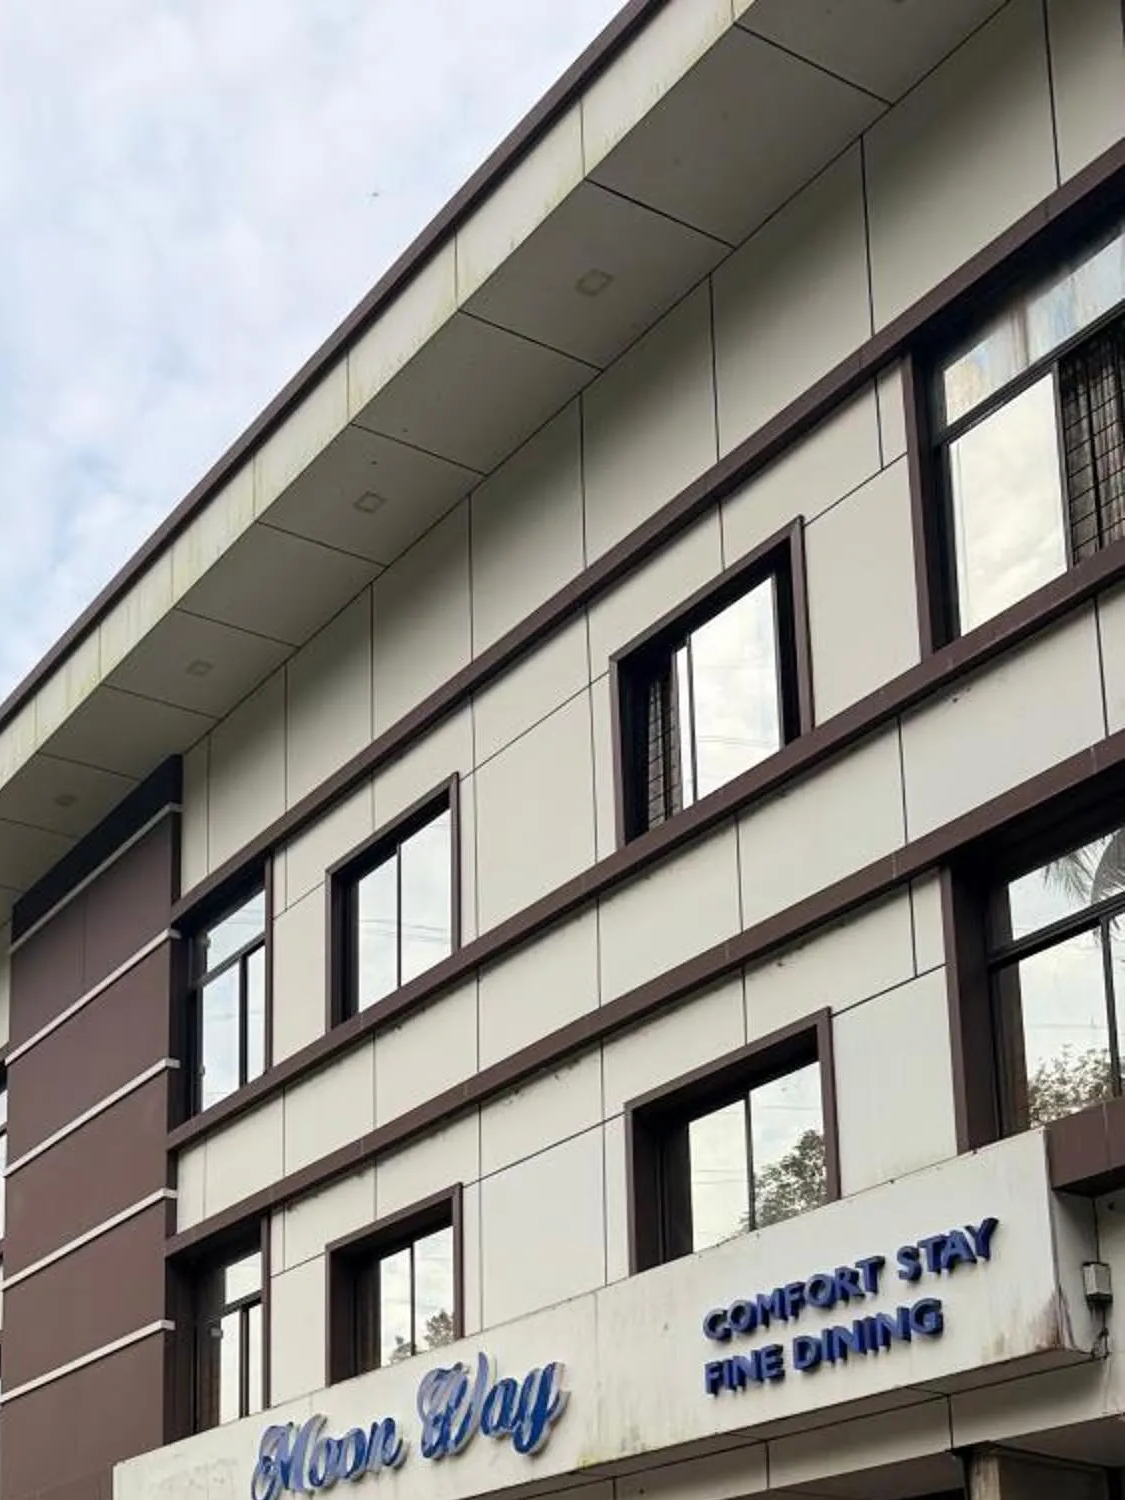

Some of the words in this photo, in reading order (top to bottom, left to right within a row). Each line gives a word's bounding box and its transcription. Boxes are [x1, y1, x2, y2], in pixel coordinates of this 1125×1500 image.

[704, 1255, 886, 1342] COMFORT
[897, 1217, 999, 1282] STAY
[705, 1343, 785, 1396] FINE
[793, 1297, 943, 1372] DINING
[417, 1351, 569, 1456] Way
